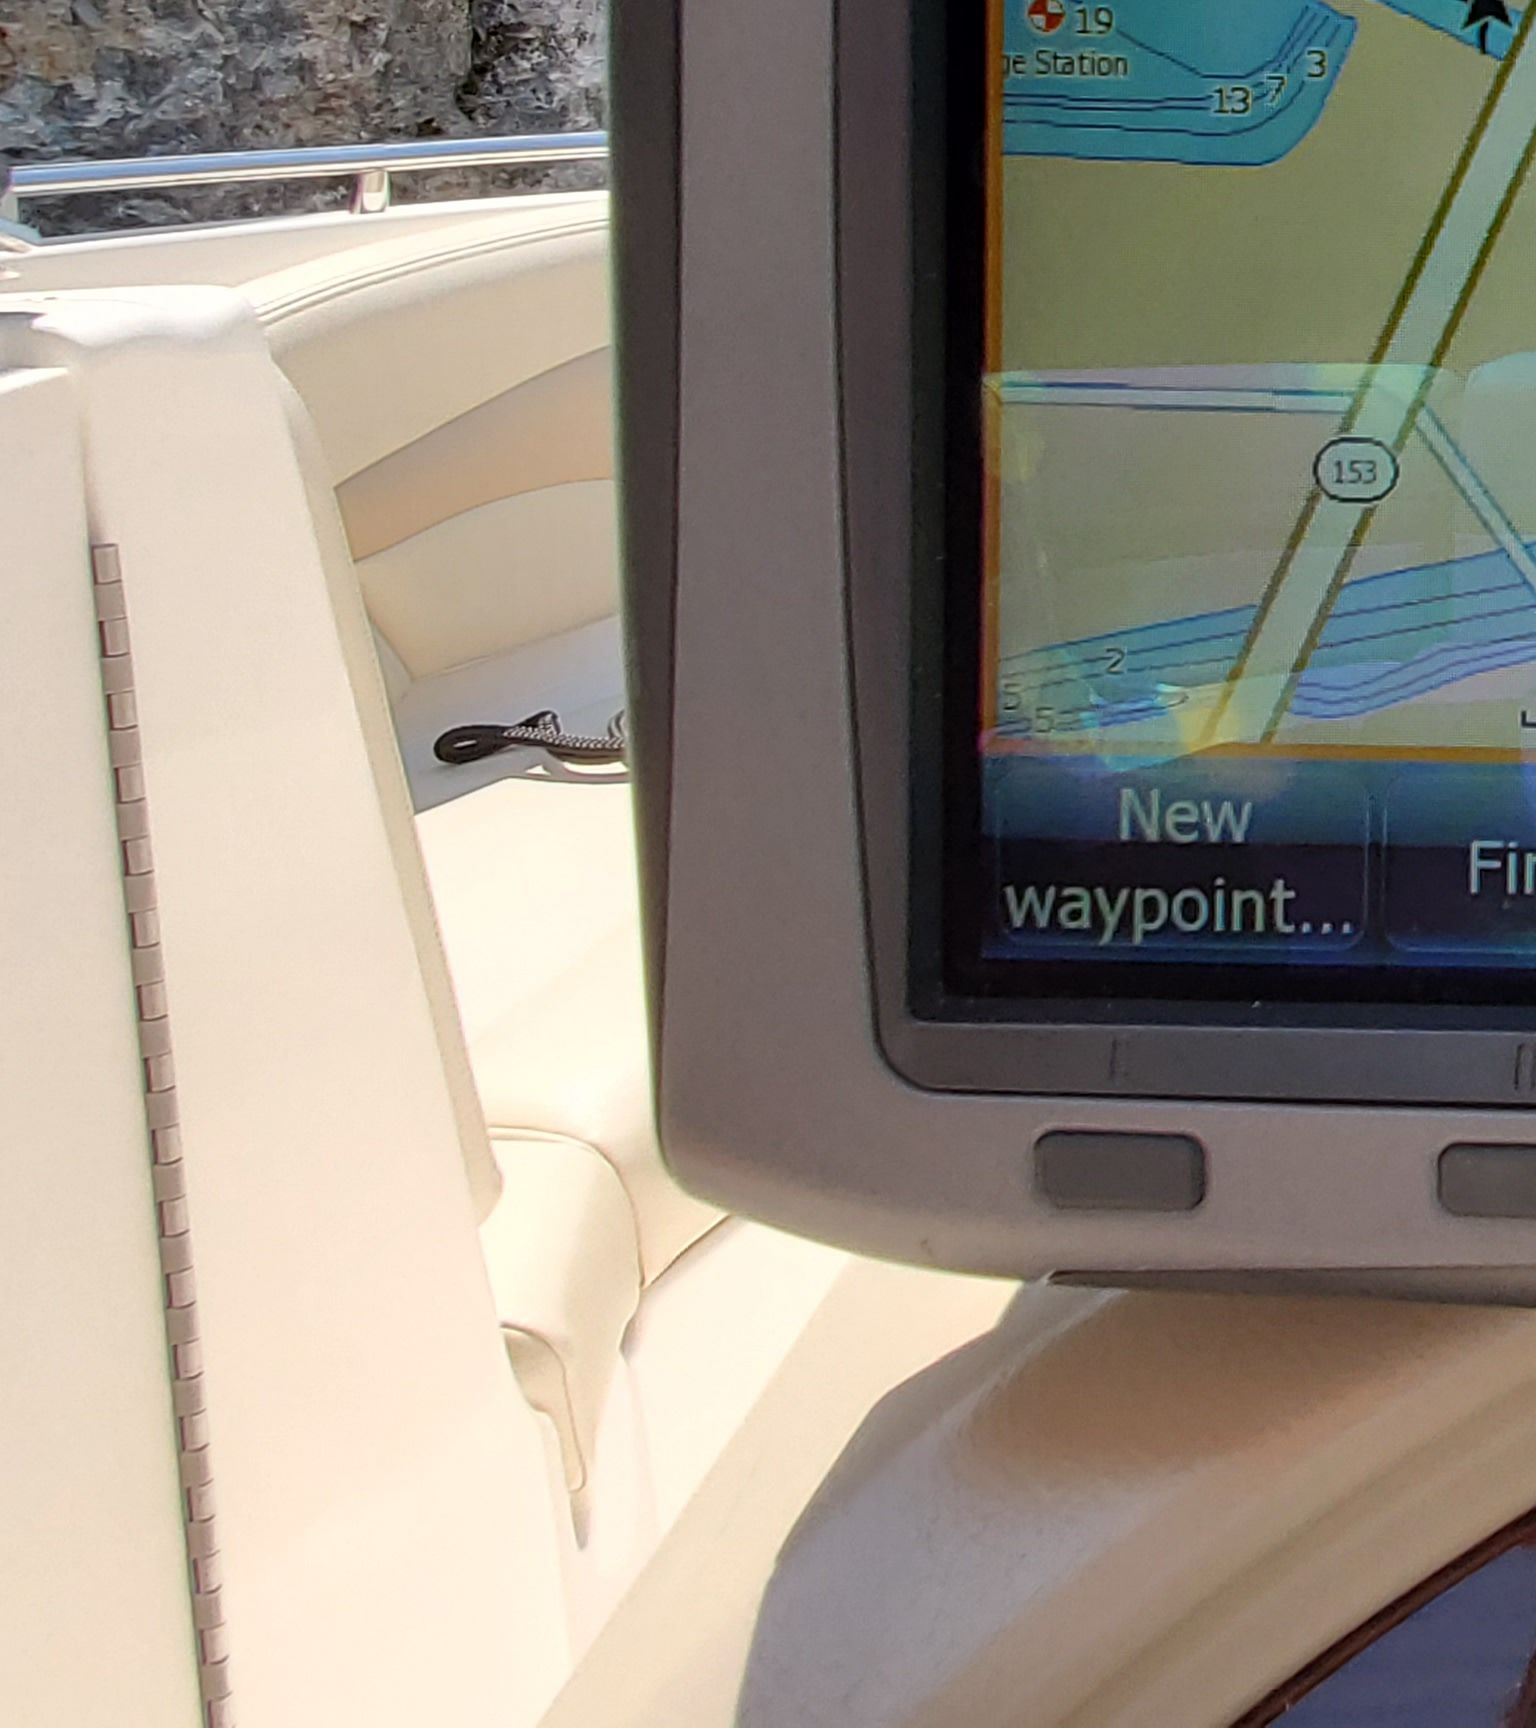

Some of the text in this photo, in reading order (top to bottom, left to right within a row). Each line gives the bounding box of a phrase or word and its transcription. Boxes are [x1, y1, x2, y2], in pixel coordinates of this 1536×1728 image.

[1074, 7, 1114, 34] 19
[1036, 50, 1128, 77] Station
[1305, 50, 1328, 78] 3
[1212, 86, 1252, 115] 13
[1332, 458, 1378, 485] 153
[1118, 787, 1252, 843] New
[1002, 877, 1354, 946] waypoint...
